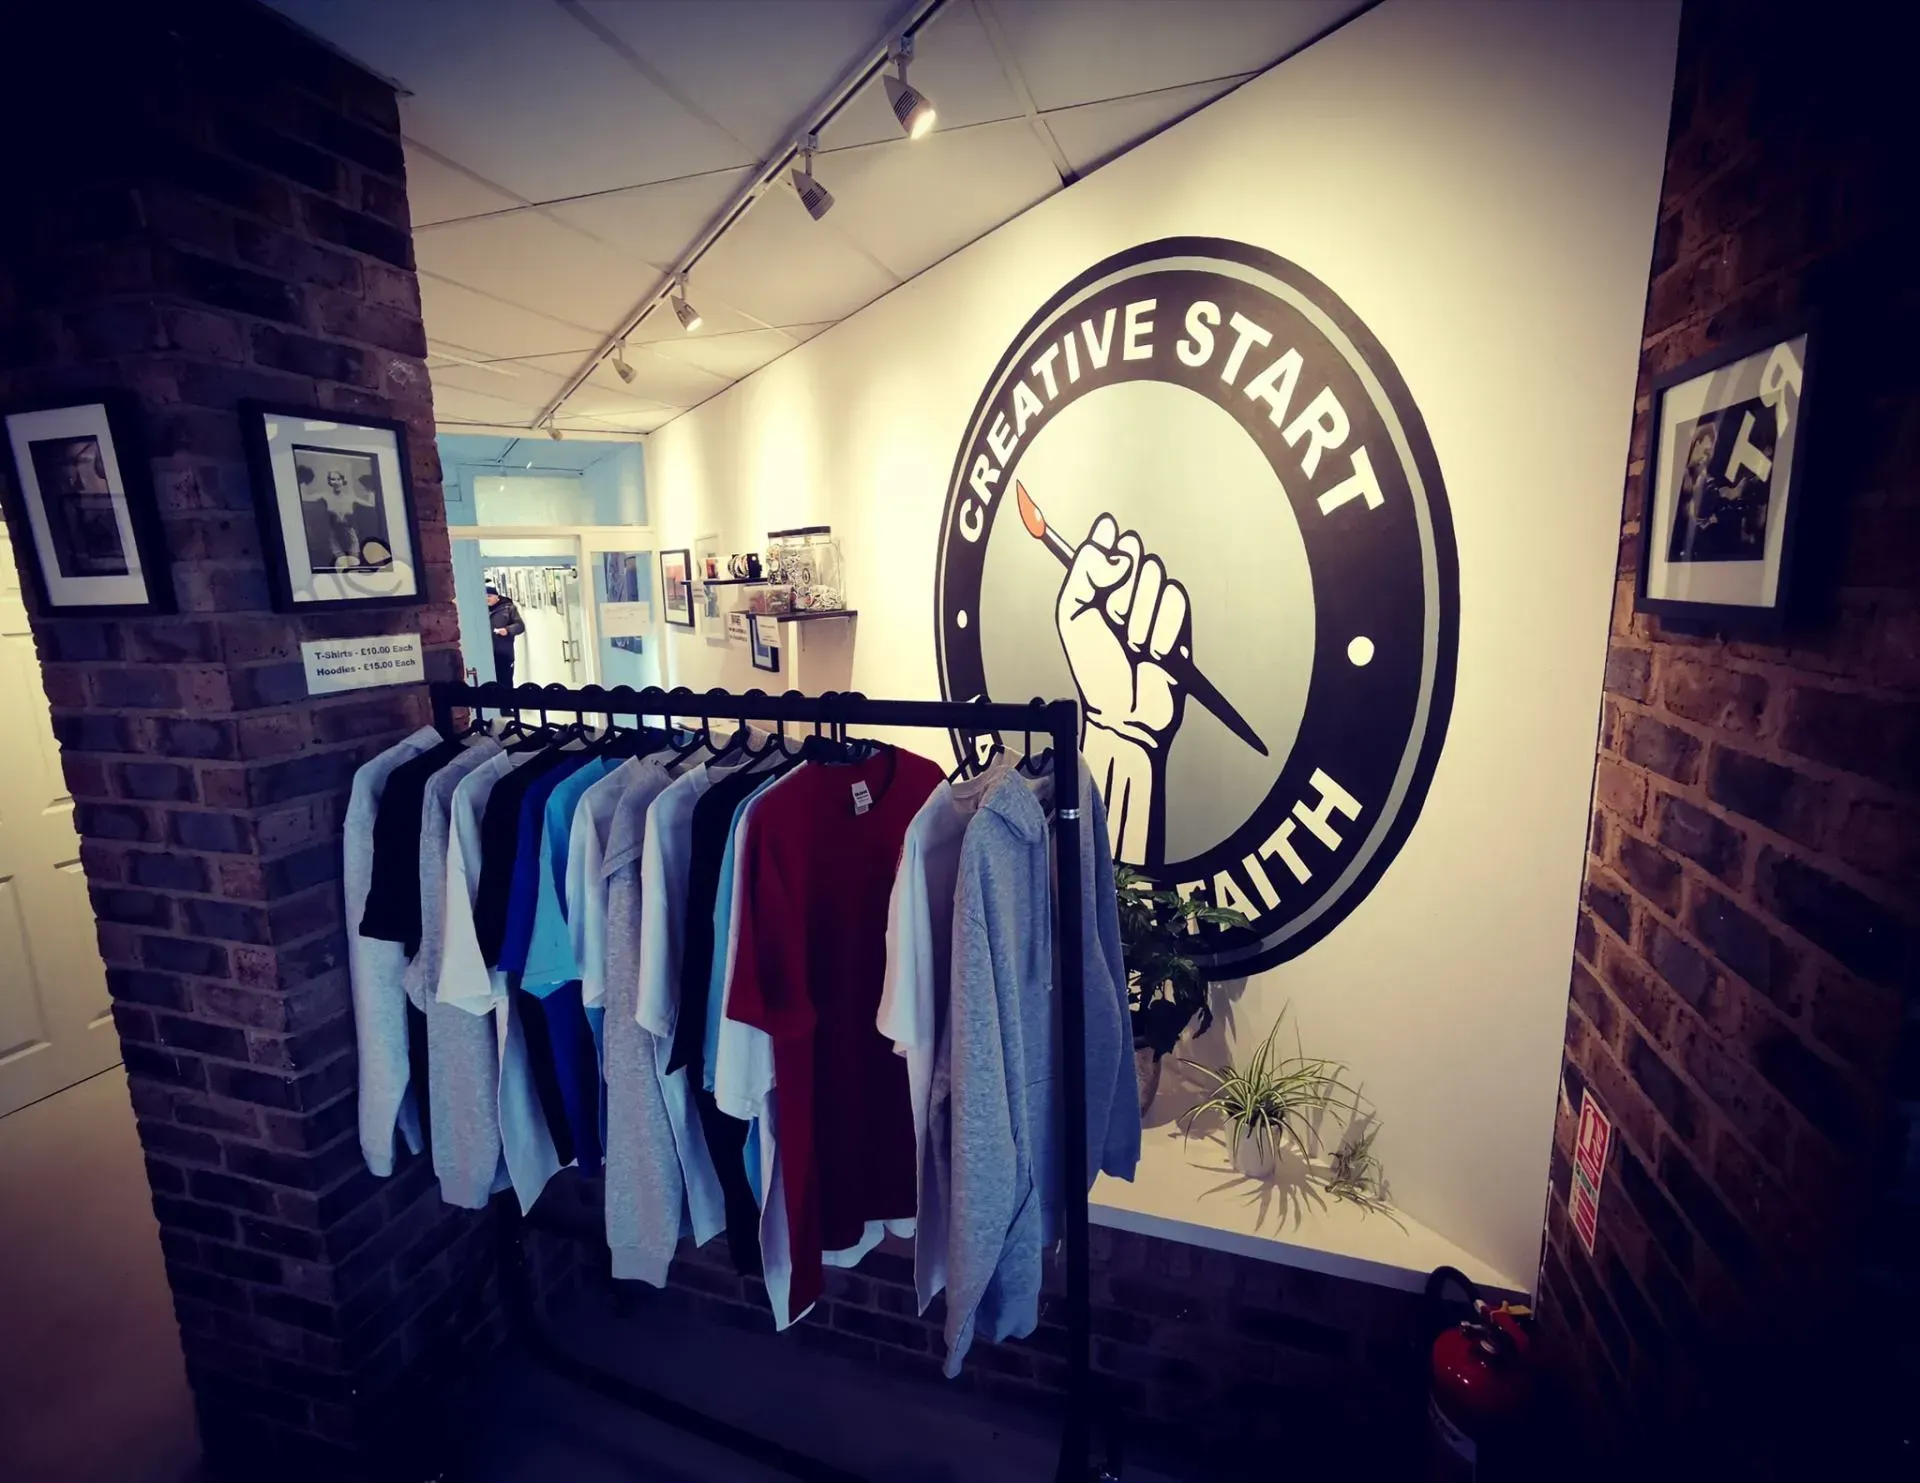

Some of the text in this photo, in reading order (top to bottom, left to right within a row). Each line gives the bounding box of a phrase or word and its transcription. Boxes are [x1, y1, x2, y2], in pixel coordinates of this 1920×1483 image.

[959, 298, 1385, 543] CREATIVE START
[315, 651, 353, 660] T-Shirts
[361, 646, 391, 656] £10.00
[393, 645, 413, 653] Each
[316, 666, 356, 676] Hoodies
[363, 661, 393, 670] £15.00
[395, 659, 416, 667] Each
[1175, 766, 1364, 936] FAITH
